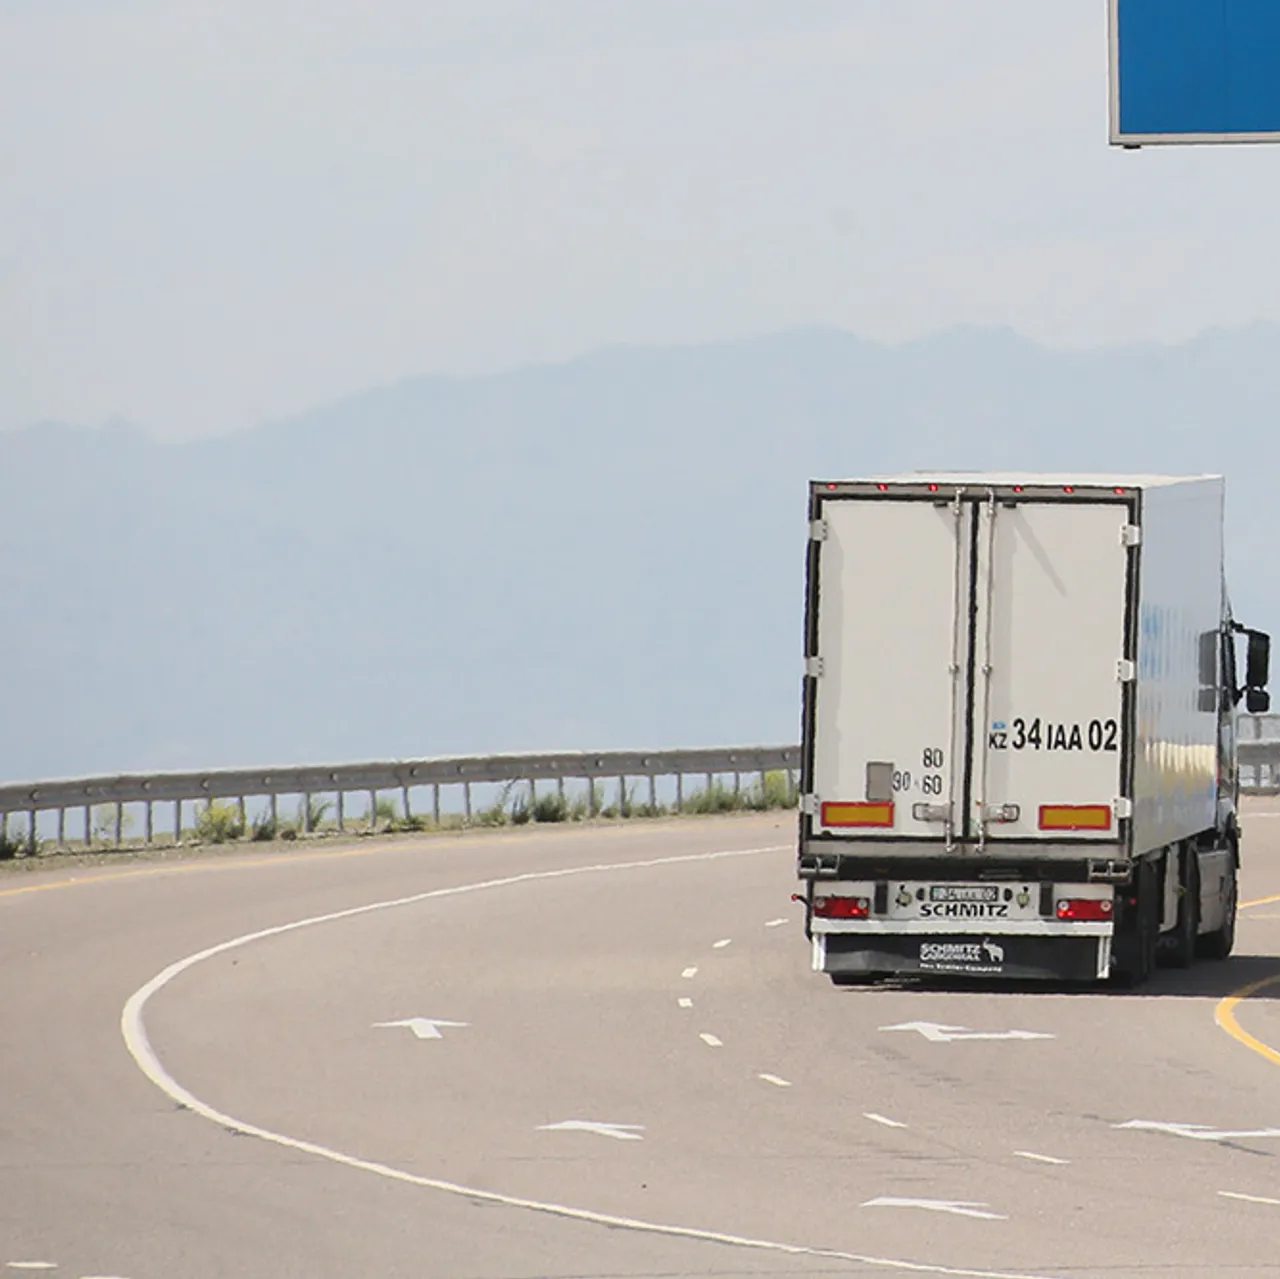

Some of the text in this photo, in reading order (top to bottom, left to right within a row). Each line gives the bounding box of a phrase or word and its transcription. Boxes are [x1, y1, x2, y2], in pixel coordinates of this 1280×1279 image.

[989, 718, 1117, 751] KZ 34 IAA 02
[923, 748, 943, 768] 80
[920, 904, 1007, 917] SCHMITZ
